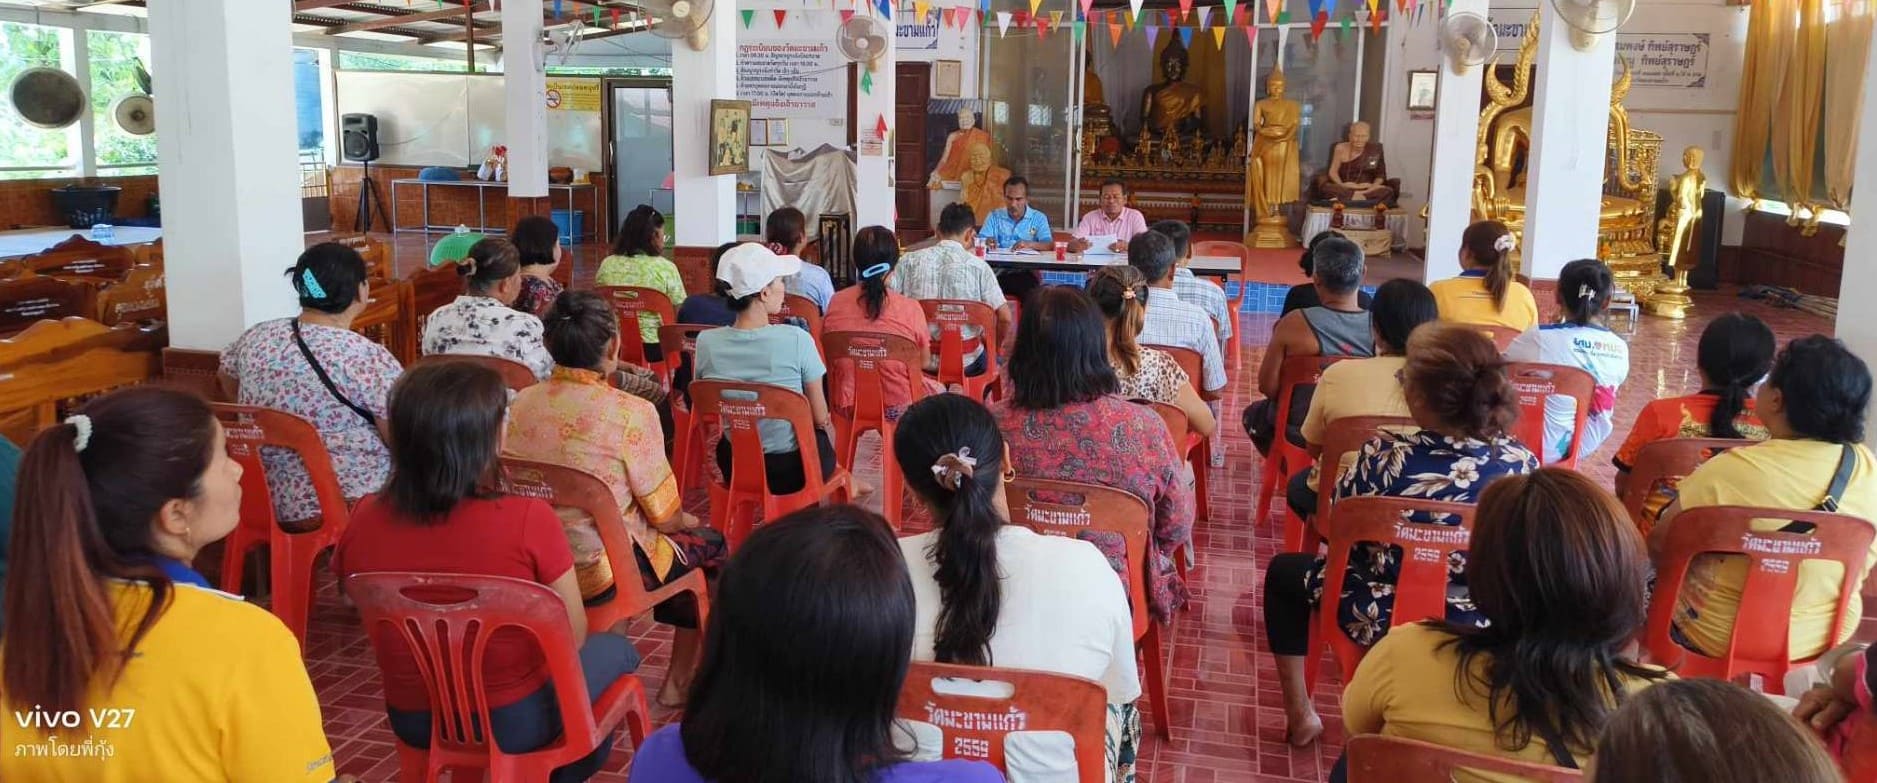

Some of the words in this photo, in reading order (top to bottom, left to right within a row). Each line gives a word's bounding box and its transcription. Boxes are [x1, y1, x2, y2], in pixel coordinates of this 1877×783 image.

[1024, 503, 1091, 526] วัดมะขามแก้ว
[924, 700, 1027, 731] วัดมะขามแก้ว
[953, 737, 990, 759] 2559
